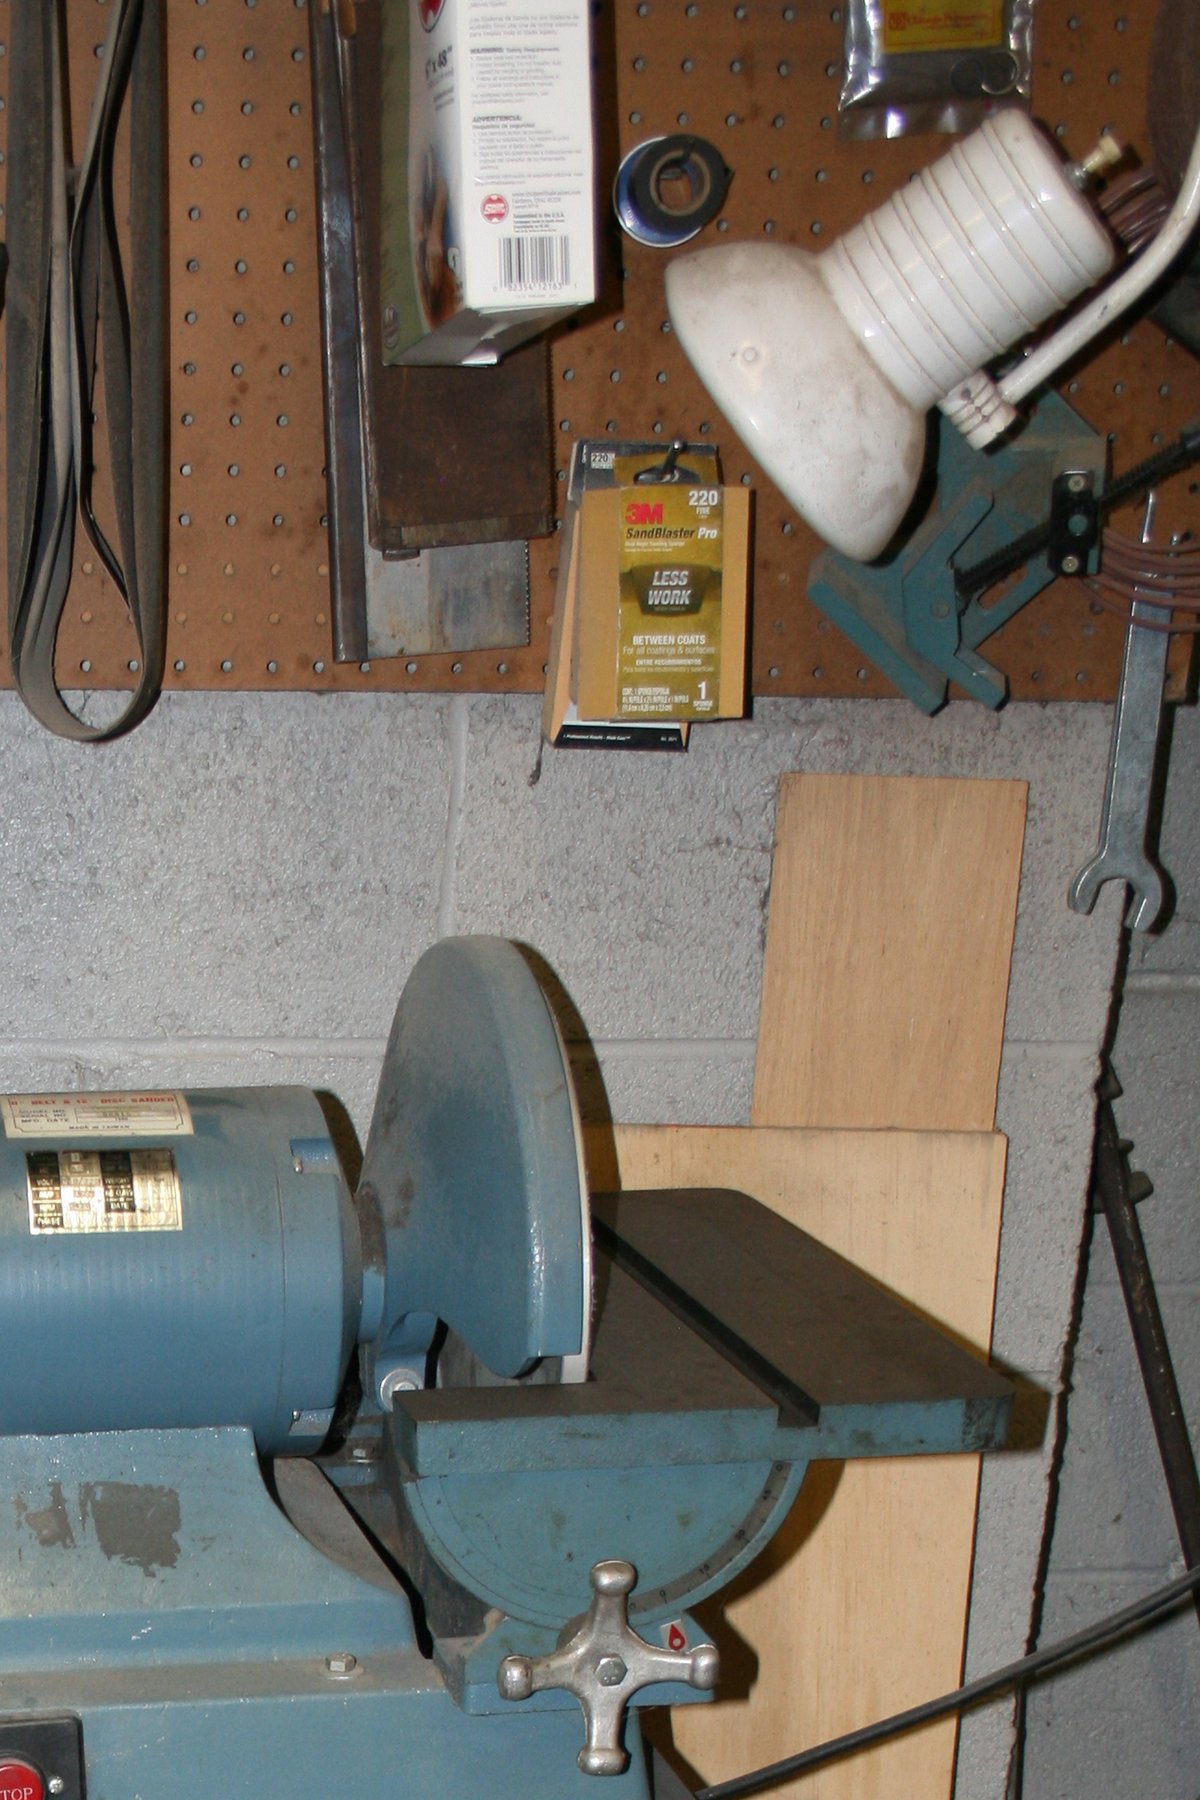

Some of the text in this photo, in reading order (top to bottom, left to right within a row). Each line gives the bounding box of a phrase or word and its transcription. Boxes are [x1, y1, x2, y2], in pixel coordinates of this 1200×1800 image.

[592, 453, 609, 463] 220
[688, 490, 718, 506] 220
[625, 503, 663, 525] 3M
[626, 527, 718, 539] SandBlaster Pro
[652, 571, 689, 586] LESS
[648, 590, 691, 605] WORK
[632, 634, 706, 646] BETWEEN COATS
[697, 681, 706, 700] 1
